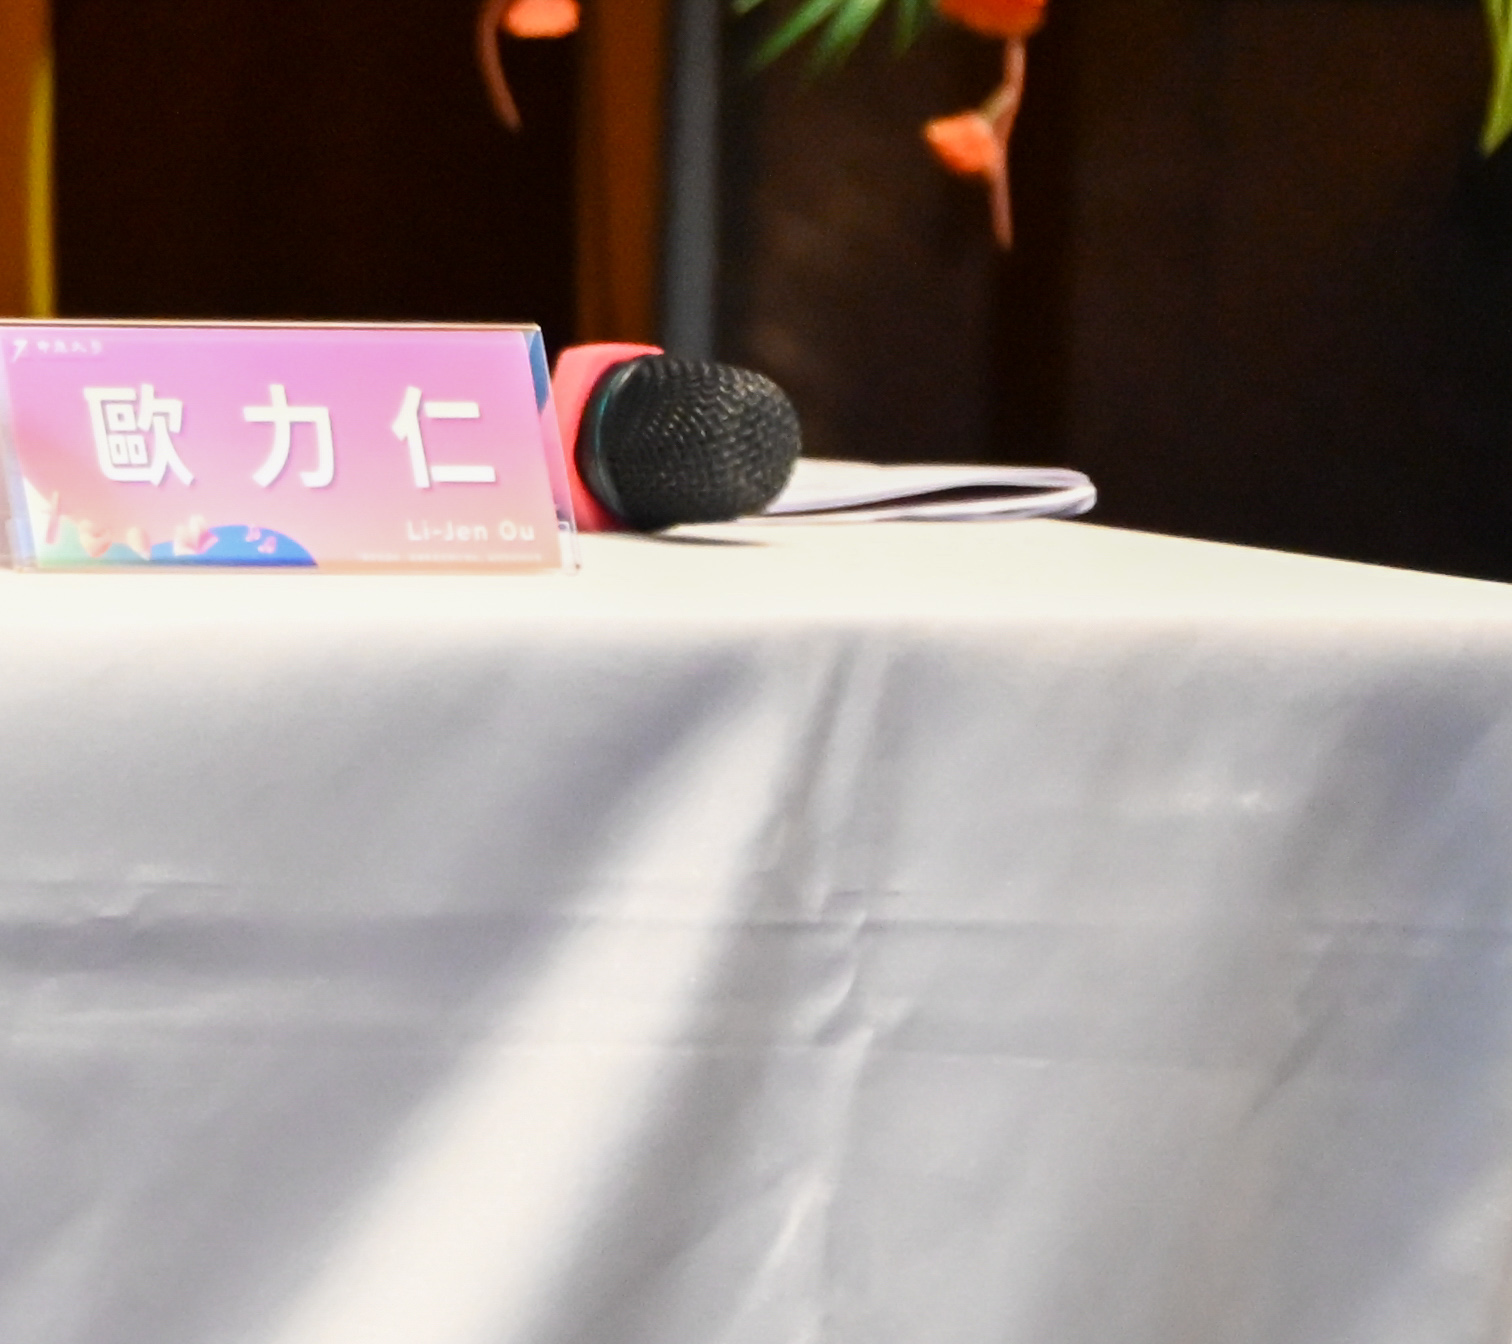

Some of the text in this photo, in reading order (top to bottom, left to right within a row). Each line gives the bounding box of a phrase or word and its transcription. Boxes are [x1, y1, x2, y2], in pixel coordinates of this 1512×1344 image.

[82, 383, 496, 489] 歐力仁
[406, 520, 536, 541] Li-Jen Ou
